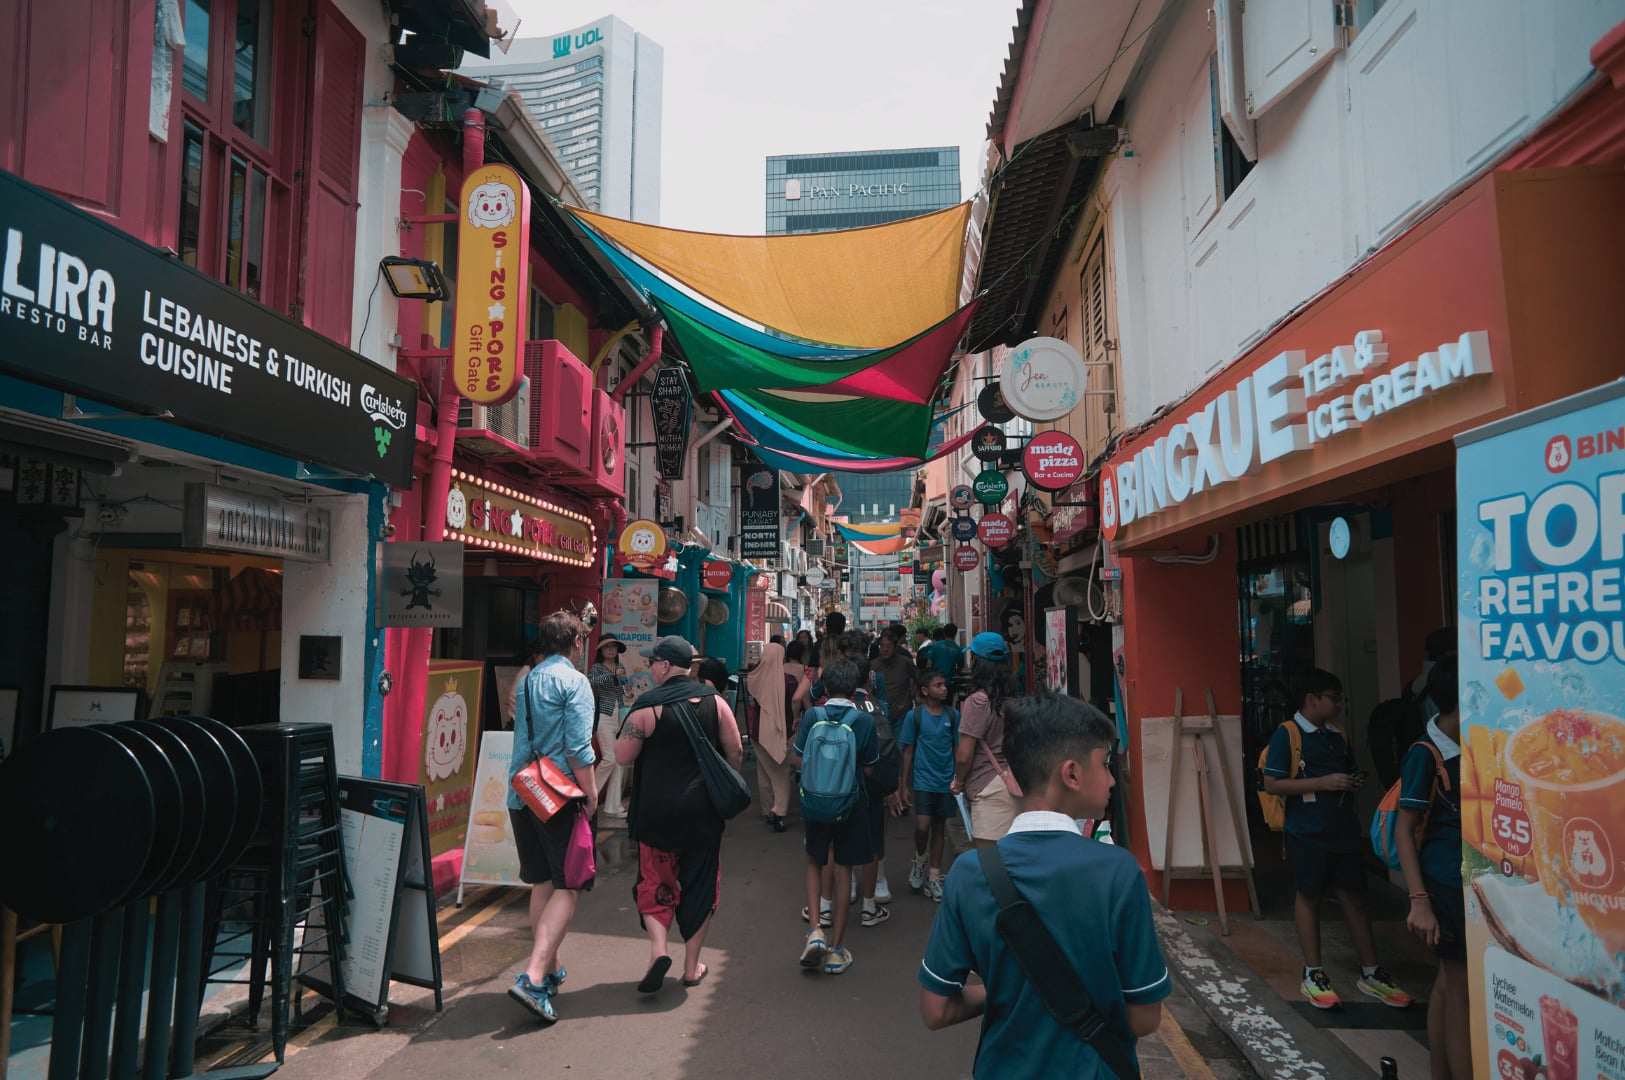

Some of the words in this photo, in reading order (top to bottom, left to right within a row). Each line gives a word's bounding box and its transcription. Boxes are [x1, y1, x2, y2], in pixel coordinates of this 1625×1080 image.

[575, 27, 604, 49] UOL
[809, 185, 840, 199] PAN
[848, 183, 909, 198] PACIFIC
[3, 227, 115, 332] LIRA
[1, 296, 66, 333] RESTO
[78, 325, 112, 350] BAR
[142, 290, 261, 369] LEBANESE
[266, 347, 280, 377] &
[284, 353, 351, 407] TURKISH
[469, 324, 483, 353] Gift
[140, 332, 234, 394] CUISINE
[467, 356, 481, 392] Gate
[1021, 361, 1048, 392] Jen
[1299, 346, 1351, 398] TEA
[1354, 330, 1378, 369] &
[658, 386, 682, 396] SHARP
[660, 376, 678, 386] STAY
[1307, 395, 1350, 444] ICE
[1352, 331, 1478, 422] CREAM
[360, 383, 407, 428] Carlsberg
[1117, 351, 1300, 526] BINGXUE
[1039, 455, 1079, 471] pizza
[976, 480, 1007, 493] Carlsberg
[986, 527, 1009, 537] pizza
[1481, 567, 1621, 616] REFRE
[1495, 779, 1520, 799] Mango
[1495, 793, 1523, 811] Pomelo
[1492, 973, 1516, 995] Lychee
[1493, 987, 1535, 1019] Watermelon
[1595, 1045, 1618, 1069] Bean
